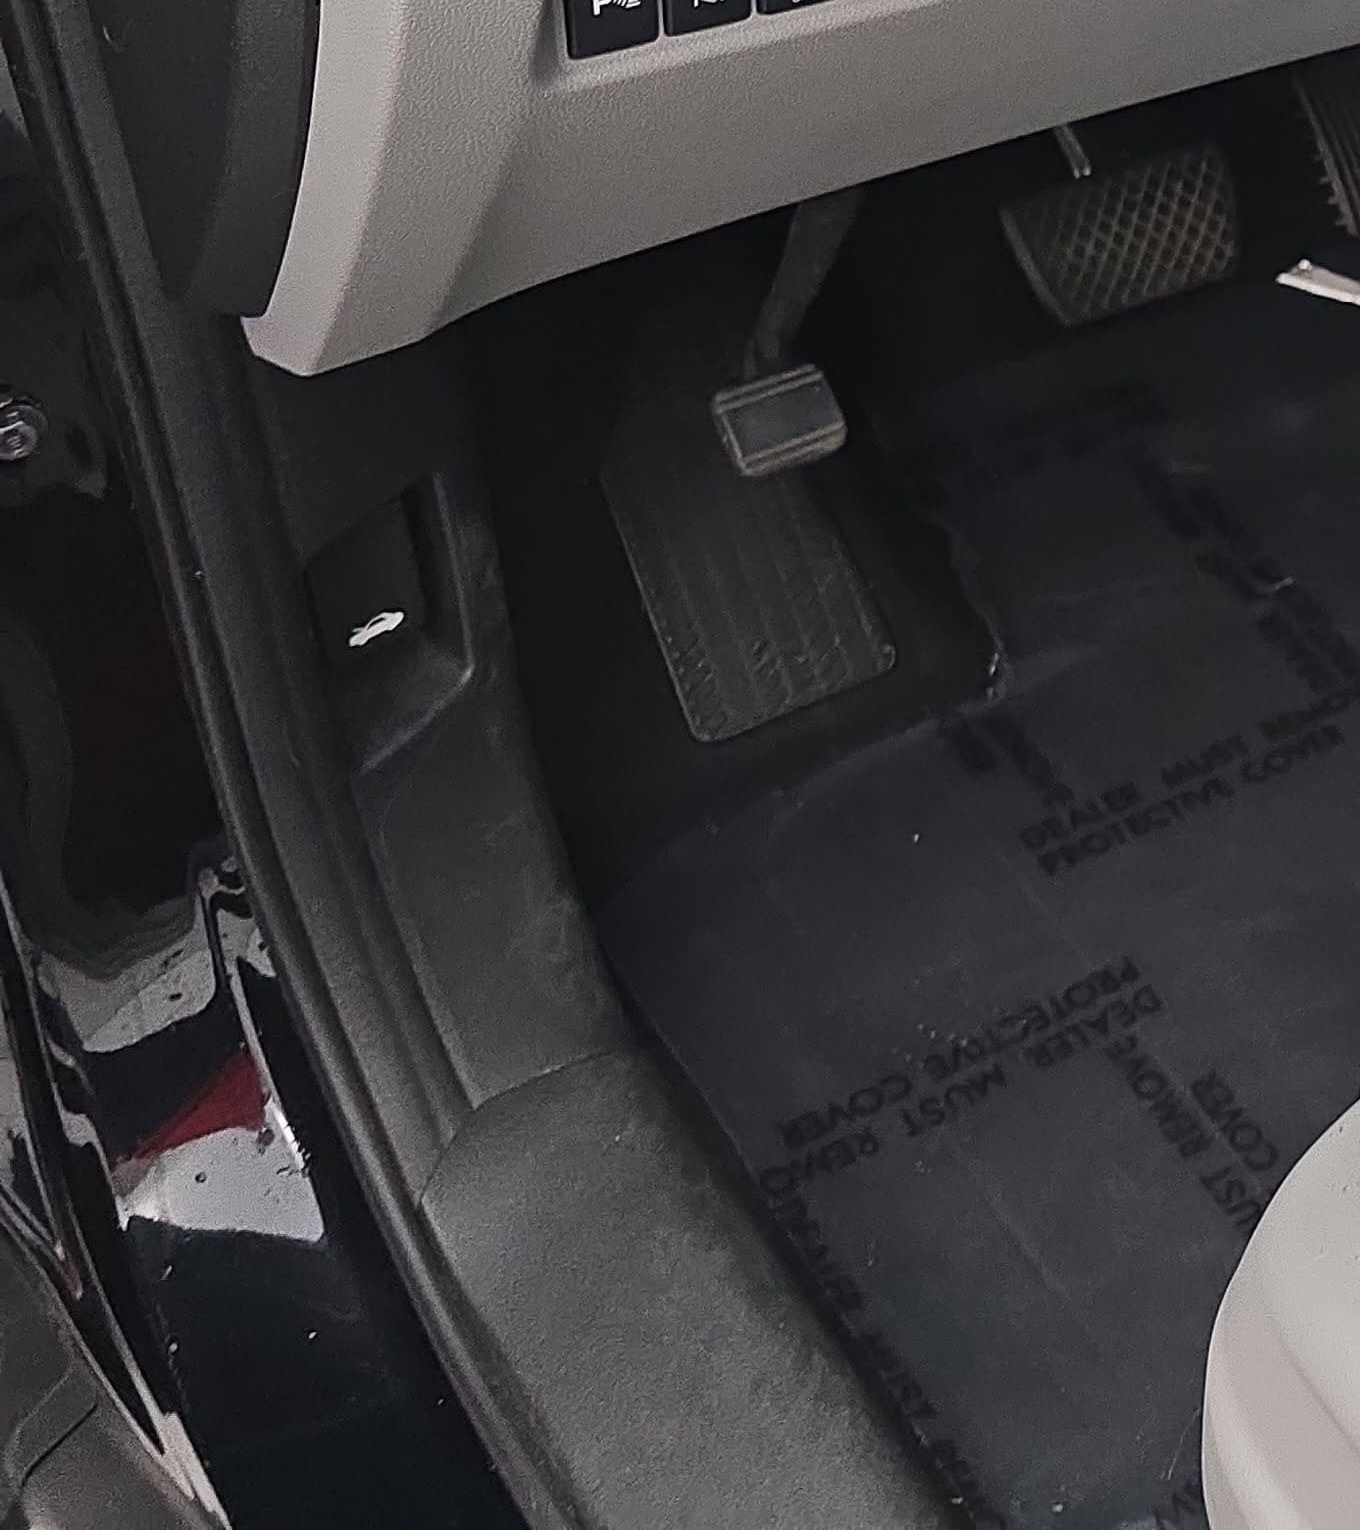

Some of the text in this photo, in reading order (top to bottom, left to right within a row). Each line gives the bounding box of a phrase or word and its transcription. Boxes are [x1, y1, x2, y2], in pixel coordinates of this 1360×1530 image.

[759, 986, 1163, 1197] DEALER MUST REMO
[780, 956, 1142, 1149] PROTECTIVE COVER
[1189, 1070, 1280, 1174] COVER
[1199, 1167, 1266, 1232] UST
